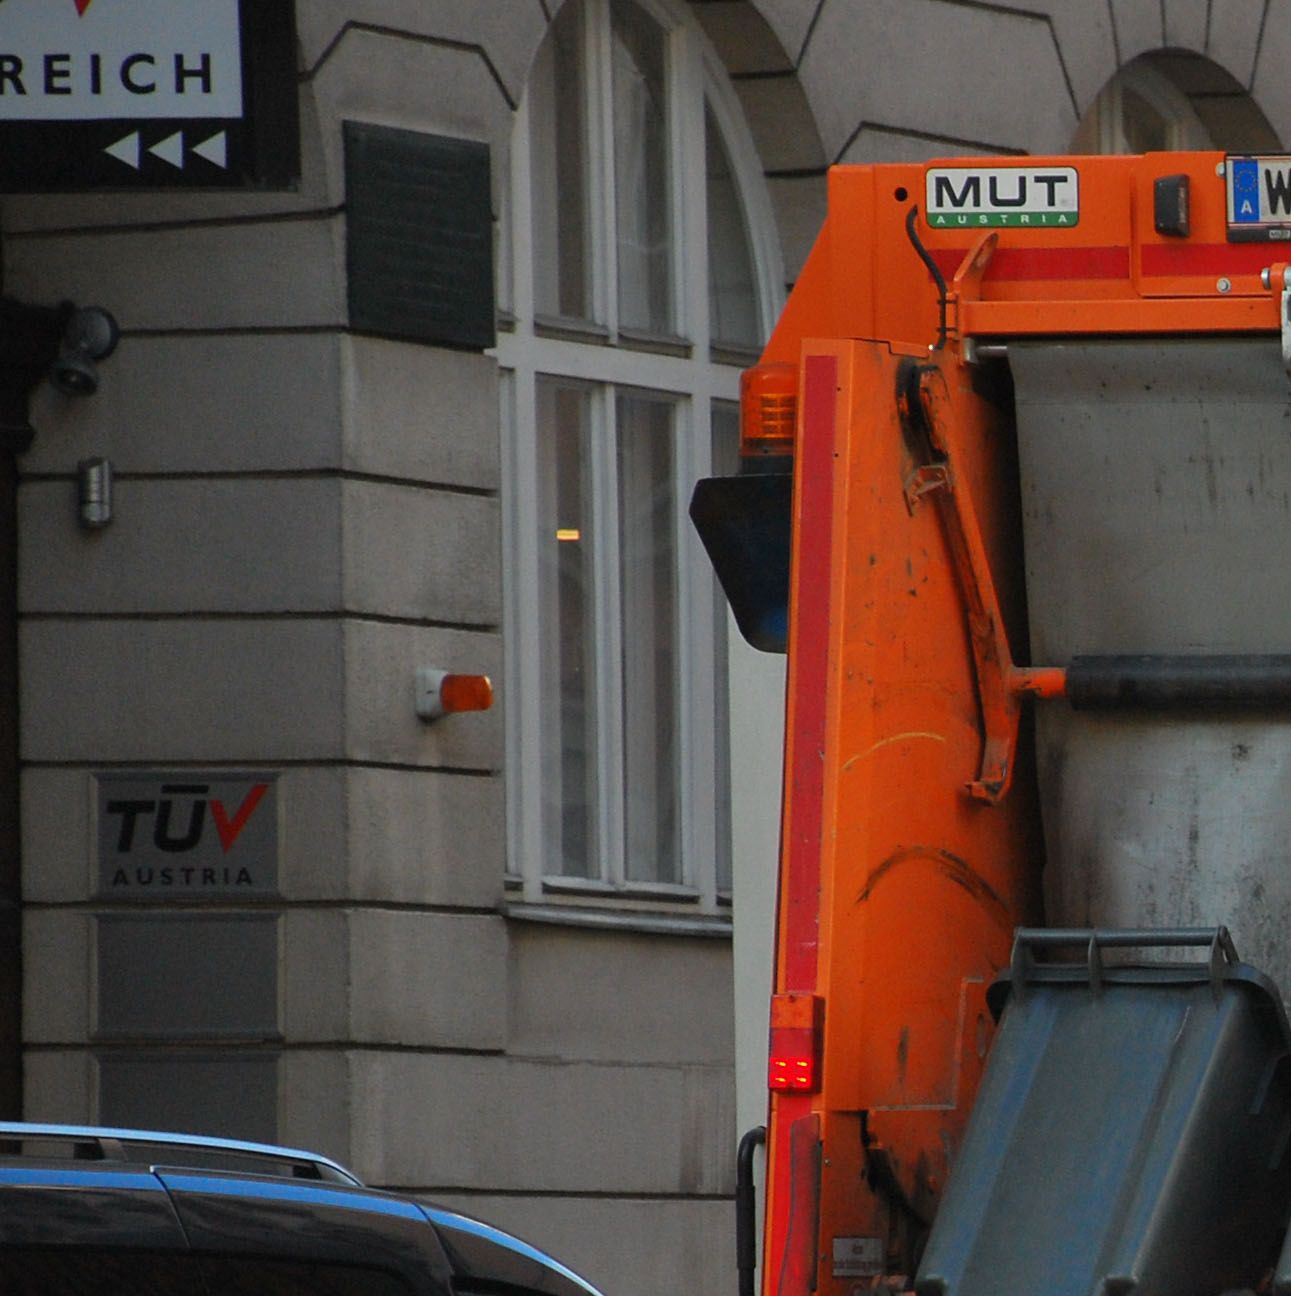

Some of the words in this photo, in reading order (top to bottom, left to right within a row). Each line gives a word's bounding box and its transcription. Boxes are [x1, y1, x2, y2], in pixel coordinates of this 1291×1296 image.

[0, 53, 211, 95] REICH
[935, 175, 1068, 208] MUT
[1240, 199, 1253, 215] A
[936, 213, 1068, 225] AUSTRIA
[111, 867, 253, 887] AUSTRIA
